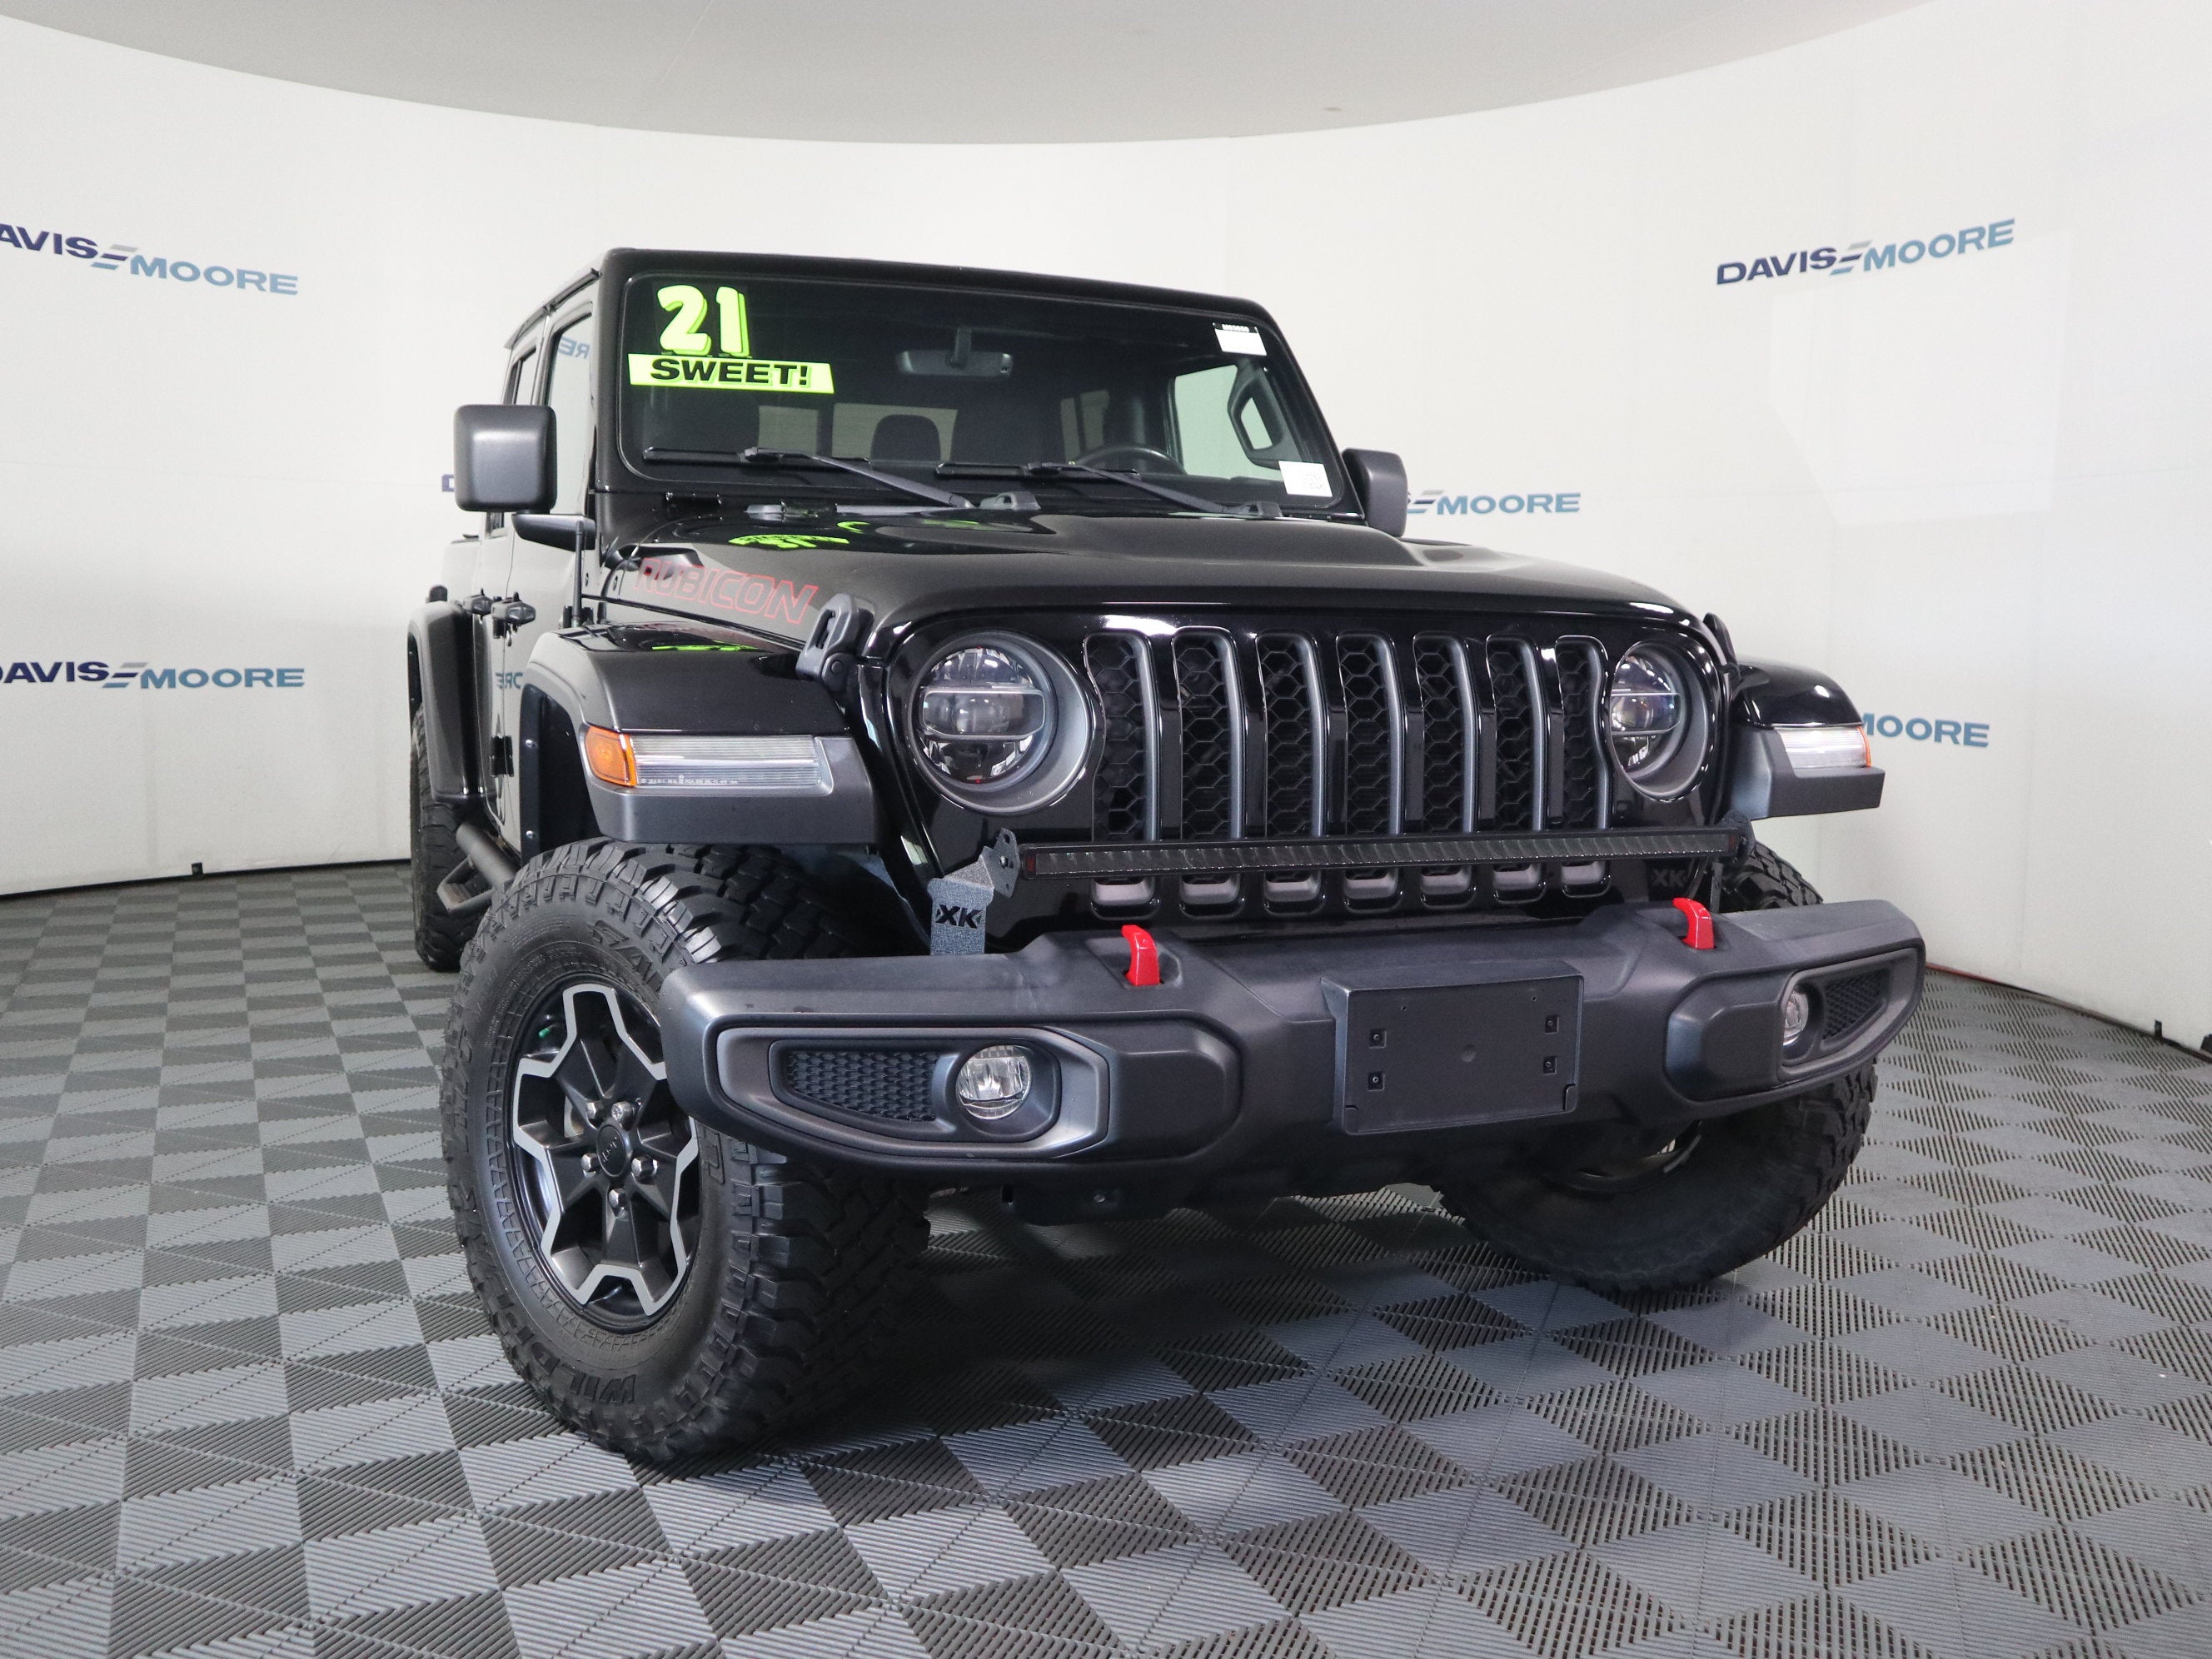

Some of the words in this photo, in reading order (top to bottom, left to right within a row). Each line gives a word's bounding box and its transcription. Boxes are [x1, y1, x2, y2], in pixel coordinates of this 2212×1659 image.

[1716, 247, 1837, 285] DAVIS
[1863, 218, 2015, 272] MOORE
[130, 254, 298, 296] MOORE
[656, 284, 750, 357] 21
[650, 358, 810, 386] SWEET!
[1437, 493, 1581, 515] MOORE
[633, 557, 820, 625] RUBICON
[0, 661, 110, 683] AVIS
[140, 668, 305, 689] MOORE
[1652, 868, 1687, 888] XK
[935, 904, 982, 929] XK
